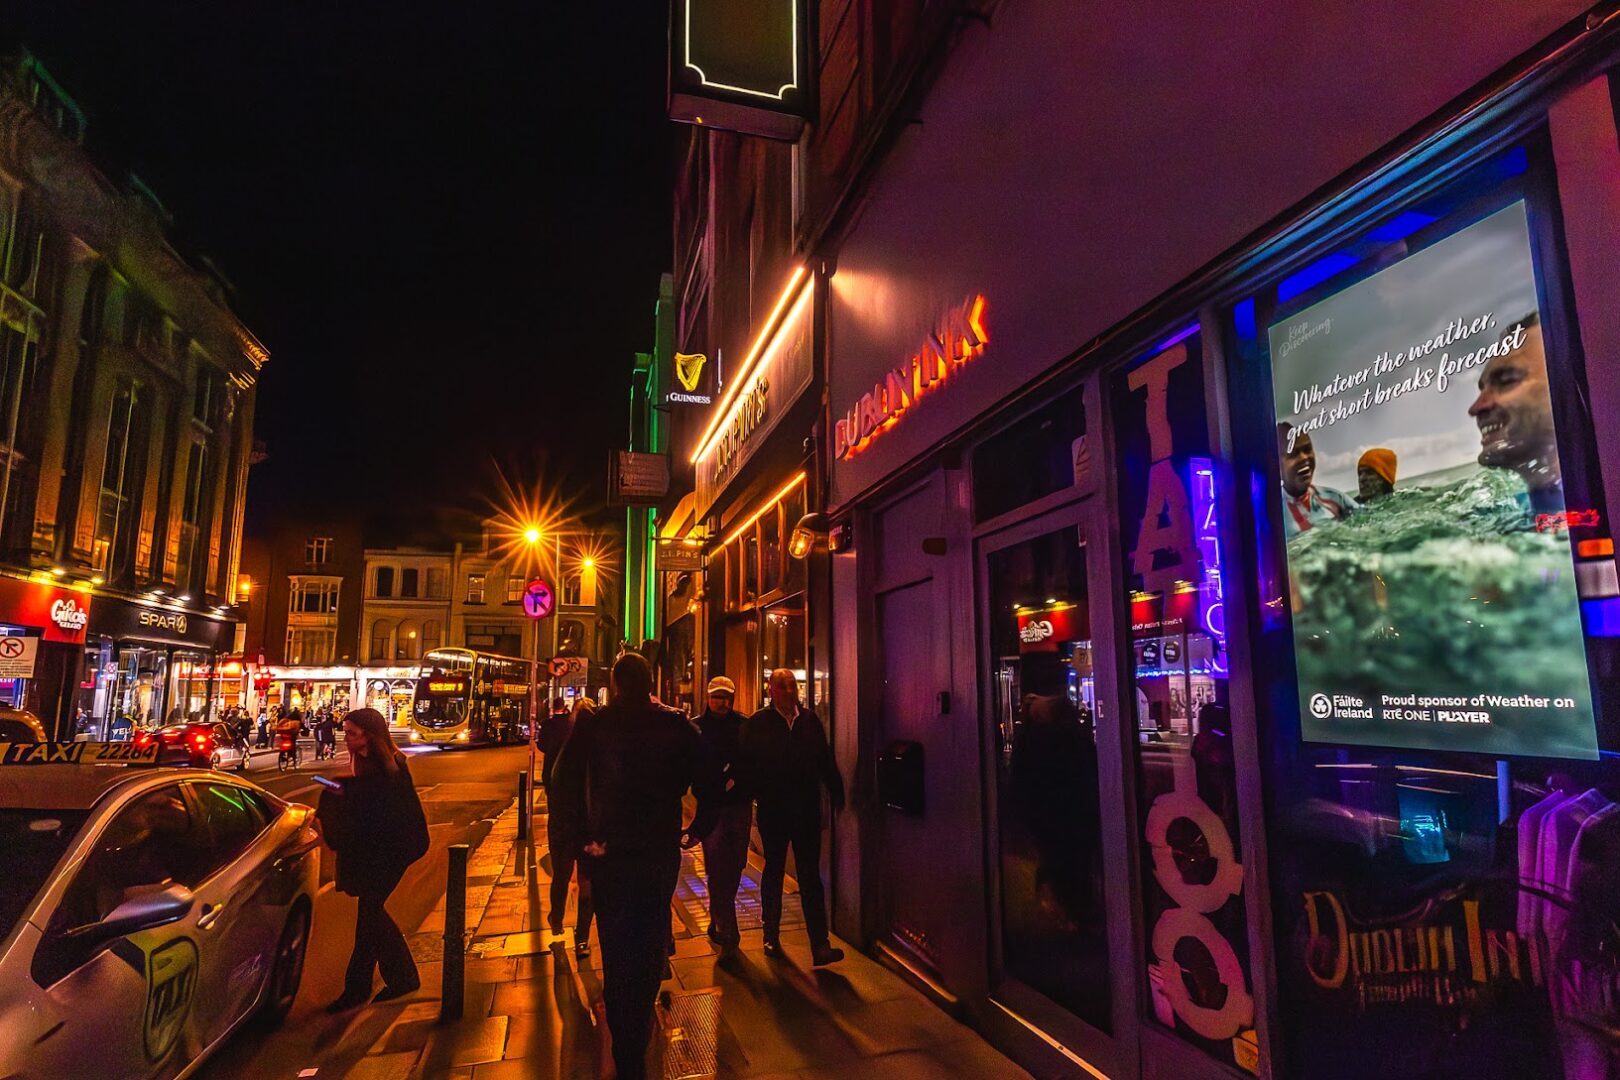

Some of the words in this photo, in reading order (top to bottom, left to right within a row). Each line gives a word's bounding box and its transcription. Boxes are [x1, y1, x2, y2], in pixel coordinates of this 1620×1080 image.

[1293, 366, 1372, 414] Whatever
[1372, 349, 1407, 378] the
[1286, 407, 1329, 454] great
[1328, 388, 1374, 426] short
[1374, 367, 1437, 405] breaks
[1437, 324, 1528, 393] forecast
[669, 391, 711, 405] GUINNESS
[139, 612, 176, 629] SPAR
[1333, 695, 1363, 708] Fáilte
[1381, 694, 1415, 706] Proud
[1418, 696, 1468, 708] sponsor
[1470, 694, 1486, 707] of
[1486, 694, 1550, 708] Weather
[1553, 698, 1575, 708] on
[1334, 707, 1374, 719] Ireland
[1404, 710, 1431, 721] ONE
[1437, 711, 1490, 723] PLAYER
[13, 743, 83, 762] TAXI
